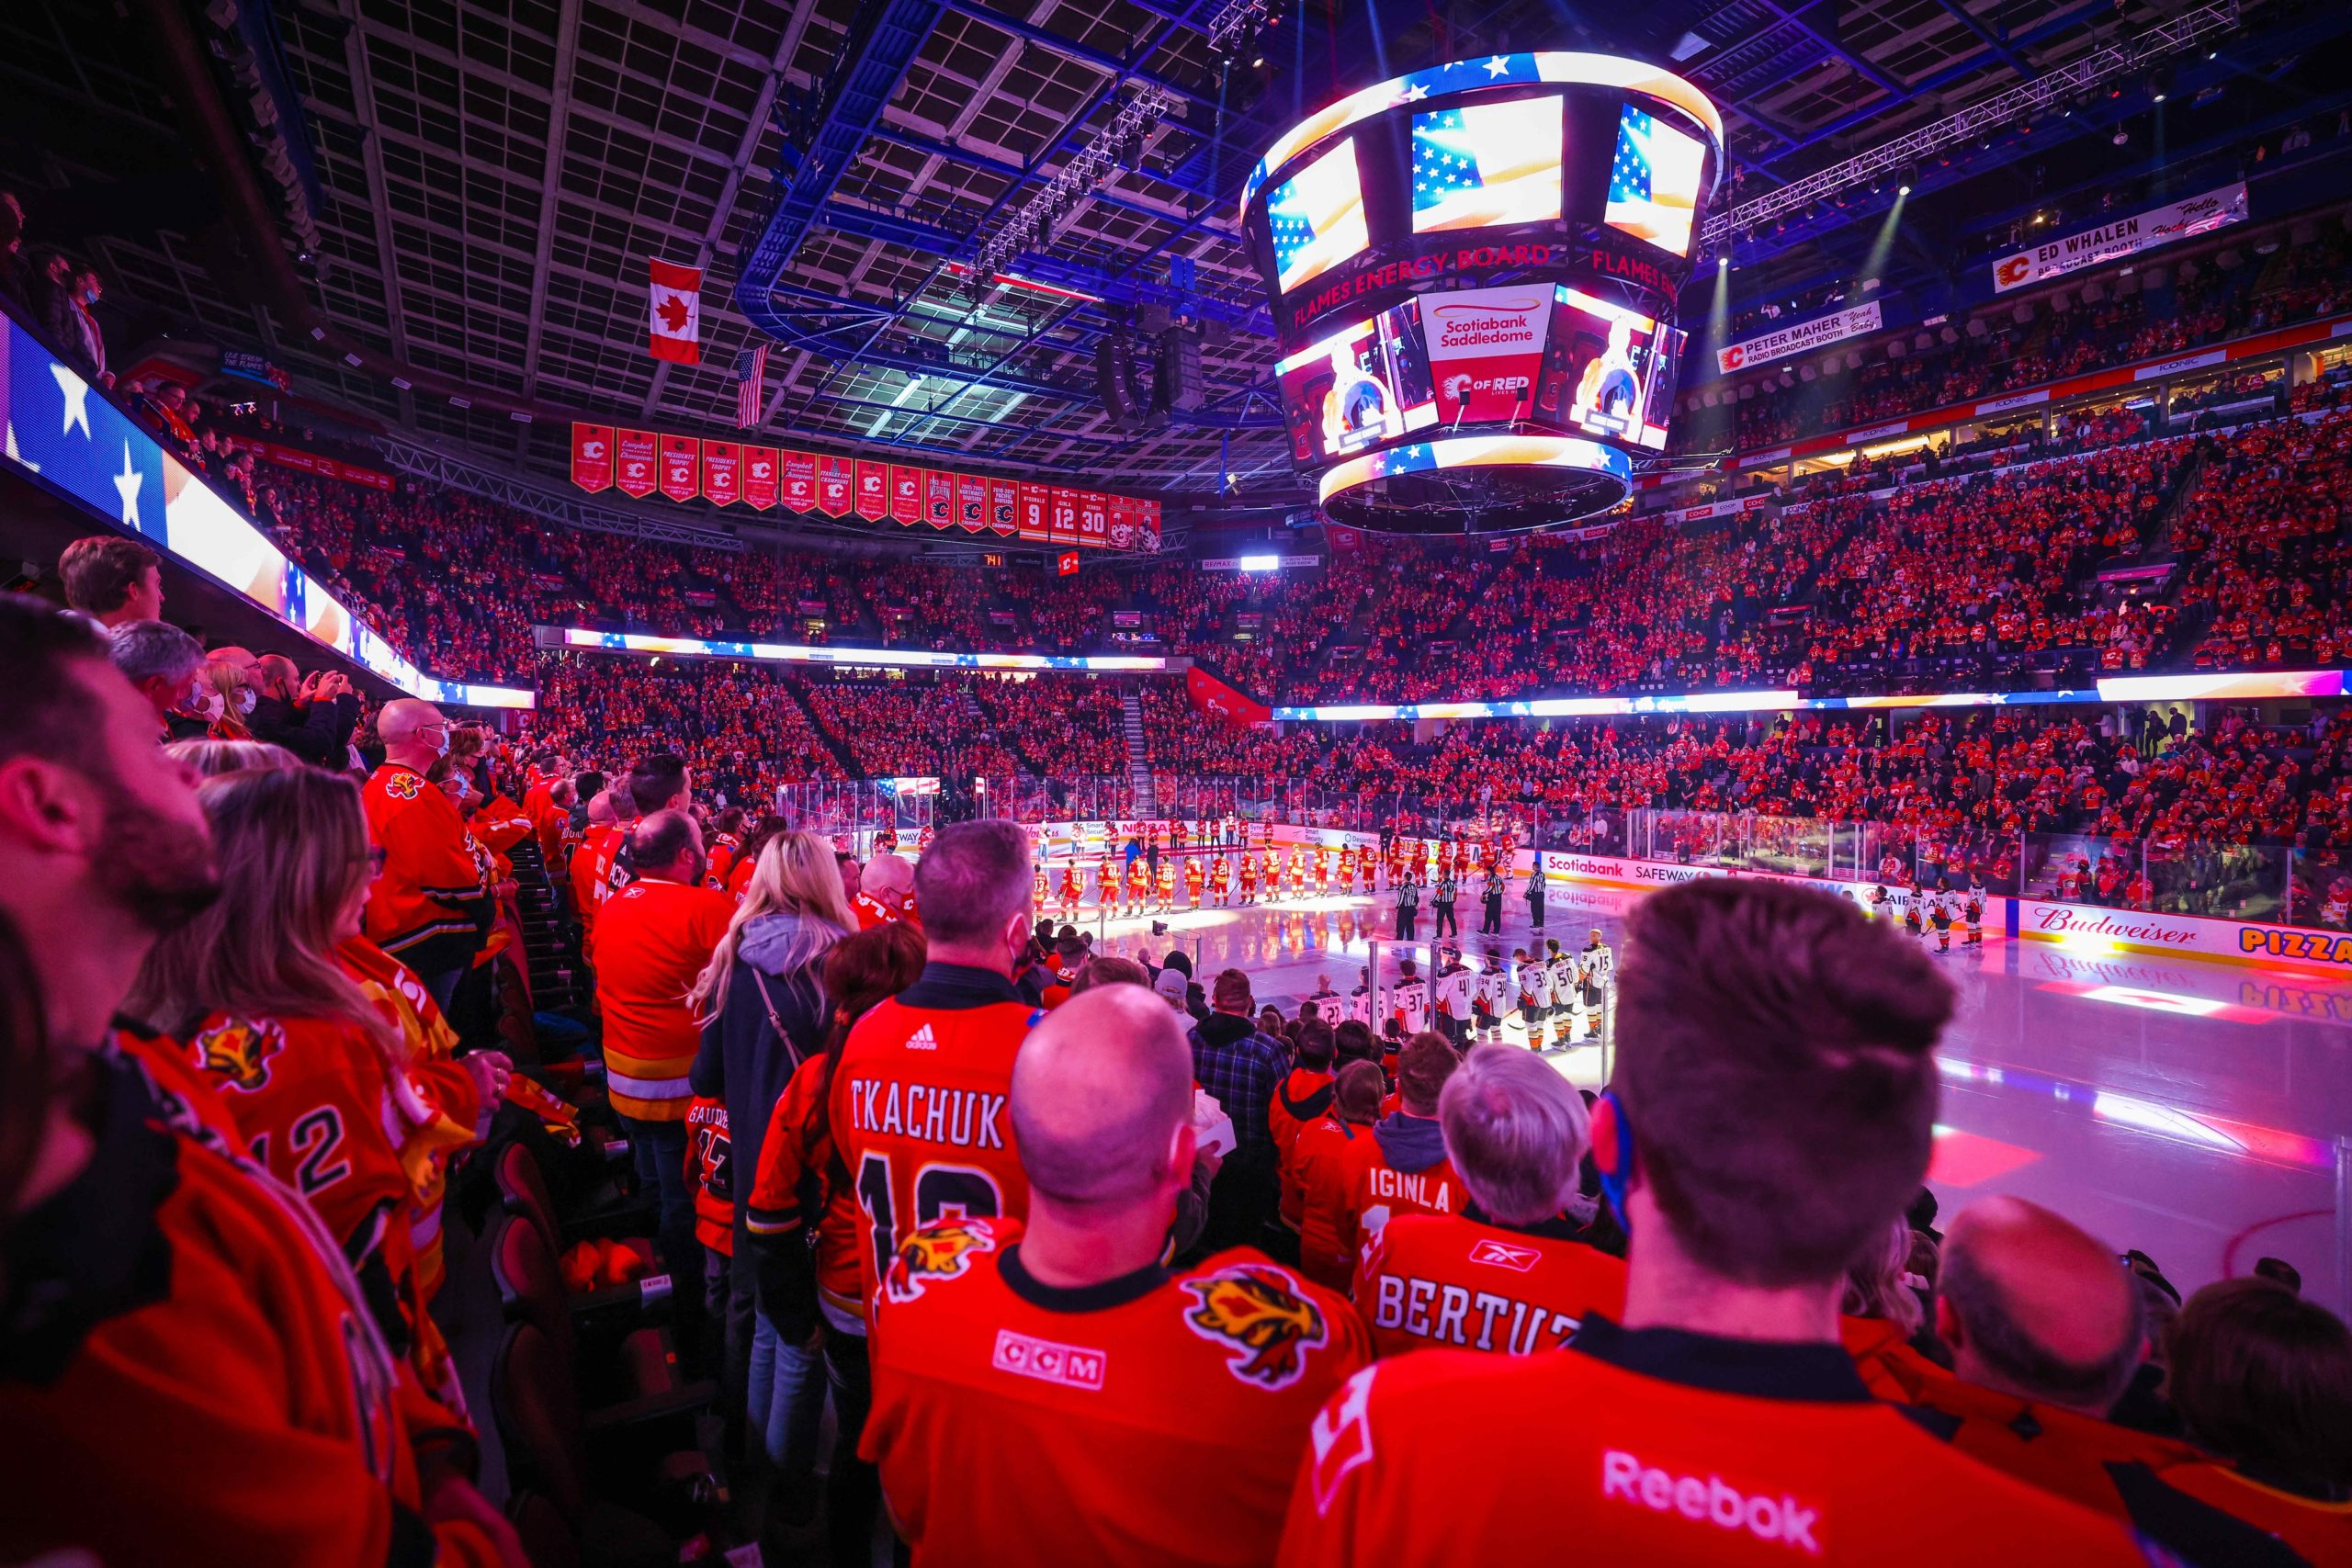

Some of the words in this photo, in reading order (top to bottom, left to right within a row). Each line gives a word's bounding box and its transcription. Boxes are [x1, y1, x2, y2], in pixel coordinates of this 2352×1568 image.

[2038, 244, 2059, 263] ED
[2065, 219, 2139, 254] WHALEN
[2104, 239, 2143, 255] BOOTH
[1593, 250, 1658, 287] FLAMES
[1294, 282, 1351, 323] FLAMES
[1356, 253, 1448, 295] ENERGY
[1457, 245, 1549, 270] BOARD
[1446, 315, 1527, 333] Scotiabank
[1441, 331, 1532, 347] Saddledome
[1746, 334, 1788, 354] PETER
[1792, 317, 1841, 340] MAHER
[1747, 351, 1770, 364] RADIO
[1771, 338, 1815, 356] BROADCAST
[1816, 329, 1843, 344] BOOTH
[2159, 357, 2199, 371] ICONIC
[1474, 380, 1492, 389] OF
[1493, 377, 1529, 389] RED
[1028, 504, 1040, 525] 9
[1055, 507, 1075, 530] 12
[1082, 511, 1104, 533] 30
[1306, 835, 1323, 843] Security
[1352, 836, 1377, 845] Desjardins
[1549, 856, 1623, 877] Scotiabank
[1635, 867, 1693, 883] SAFEWAY
[2034, 908, 2197, 944] Budweiser
[2239, 928, 2352, 964] PIZZA
[1600, 956, 1609, 971] 15
[1556, 967, 1573, 987] 50
[1459, 979, 1470, 997] 41
[1409, 993, 1423, 1012] 37
[906, 1040, 937, 1051] adidas
[851, 1079, 1005, 1148] TKACHUK
[1370, 1168, 1450, 1213] IGINLA
[1375, 1275, 1583, 1358] BERTUZ
[998, 1337, 1102, 1384] CCM
[1603, 1449, 1821, 1554] Reebok
